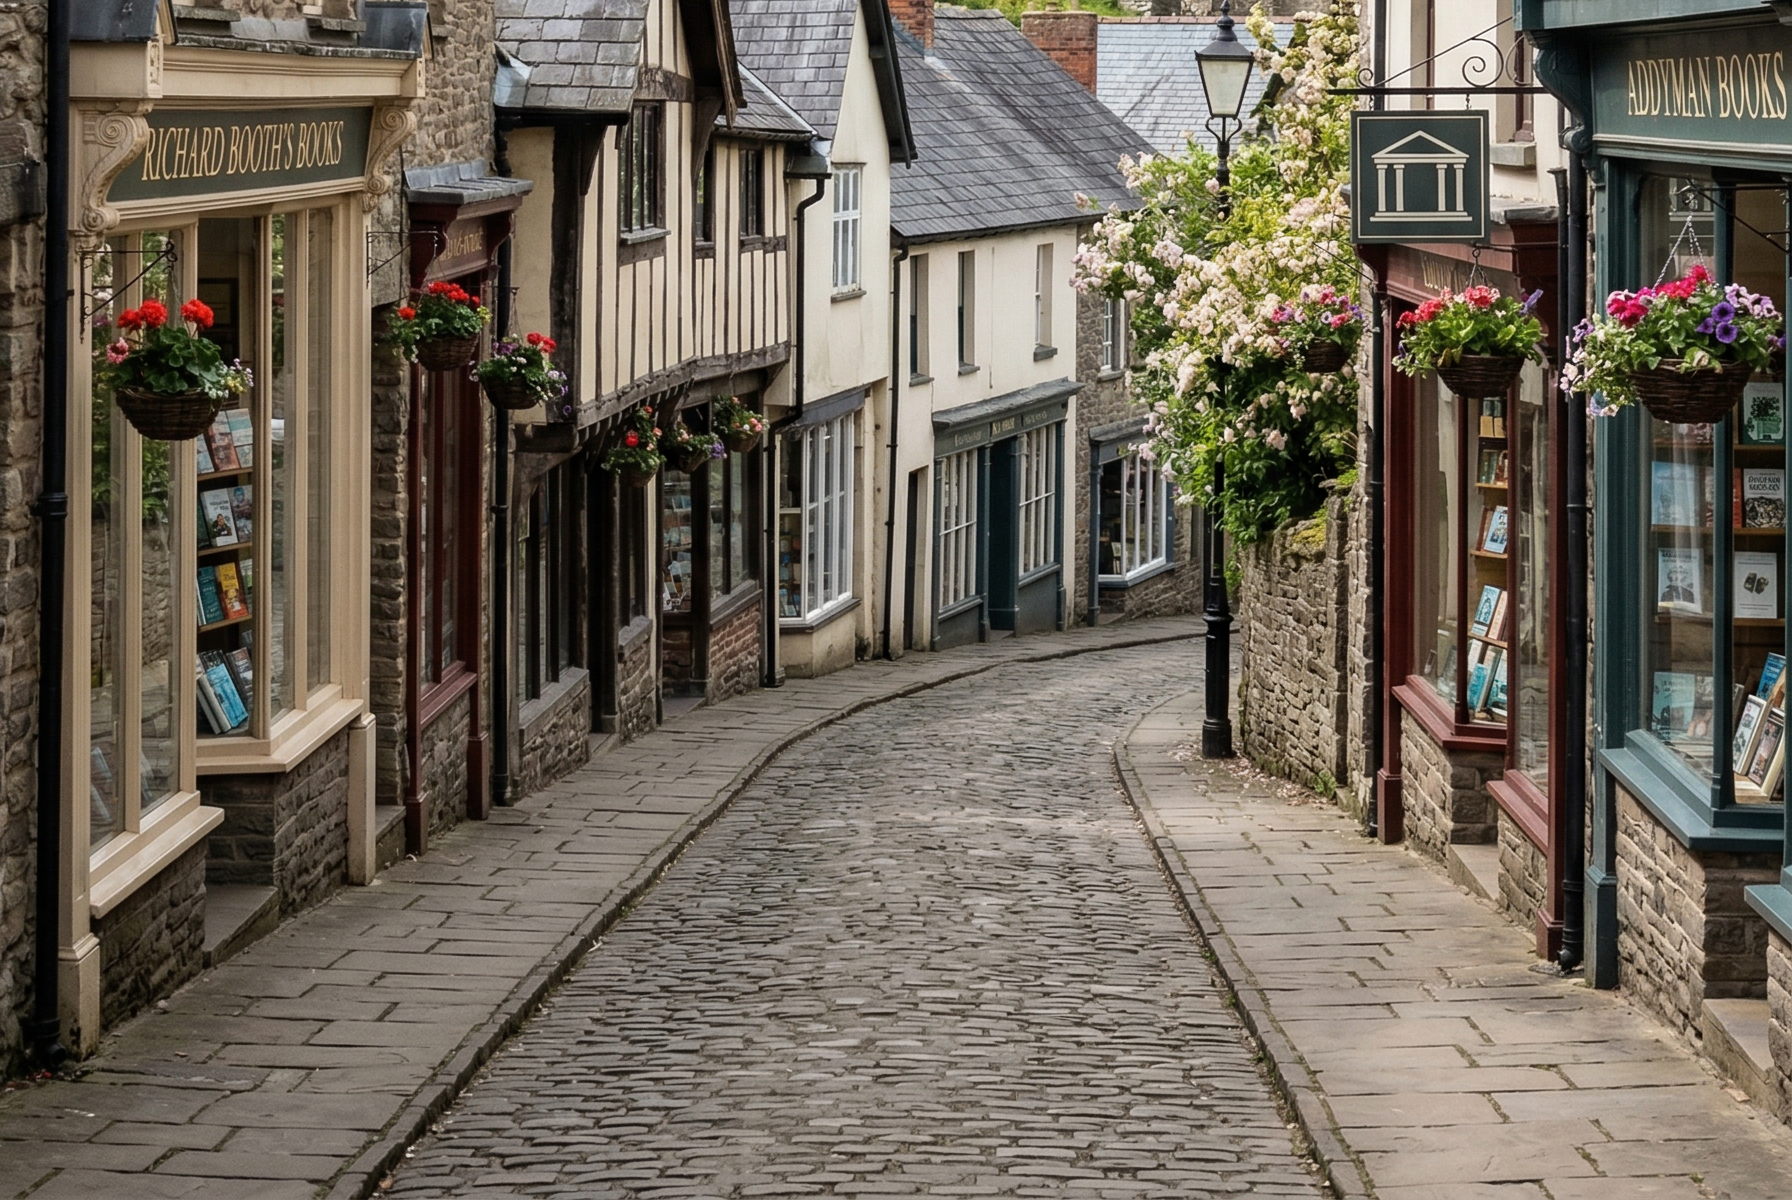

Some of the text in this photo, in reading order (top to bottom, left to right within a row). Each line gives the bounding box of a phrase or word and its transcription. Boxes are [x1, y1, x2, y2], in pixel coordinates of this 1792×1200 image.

[1628, 51, 1787, 120] ADDYMAN BOOKS
[141, 121, 343, 180] RICHARD BOOTH'S BOOKS
